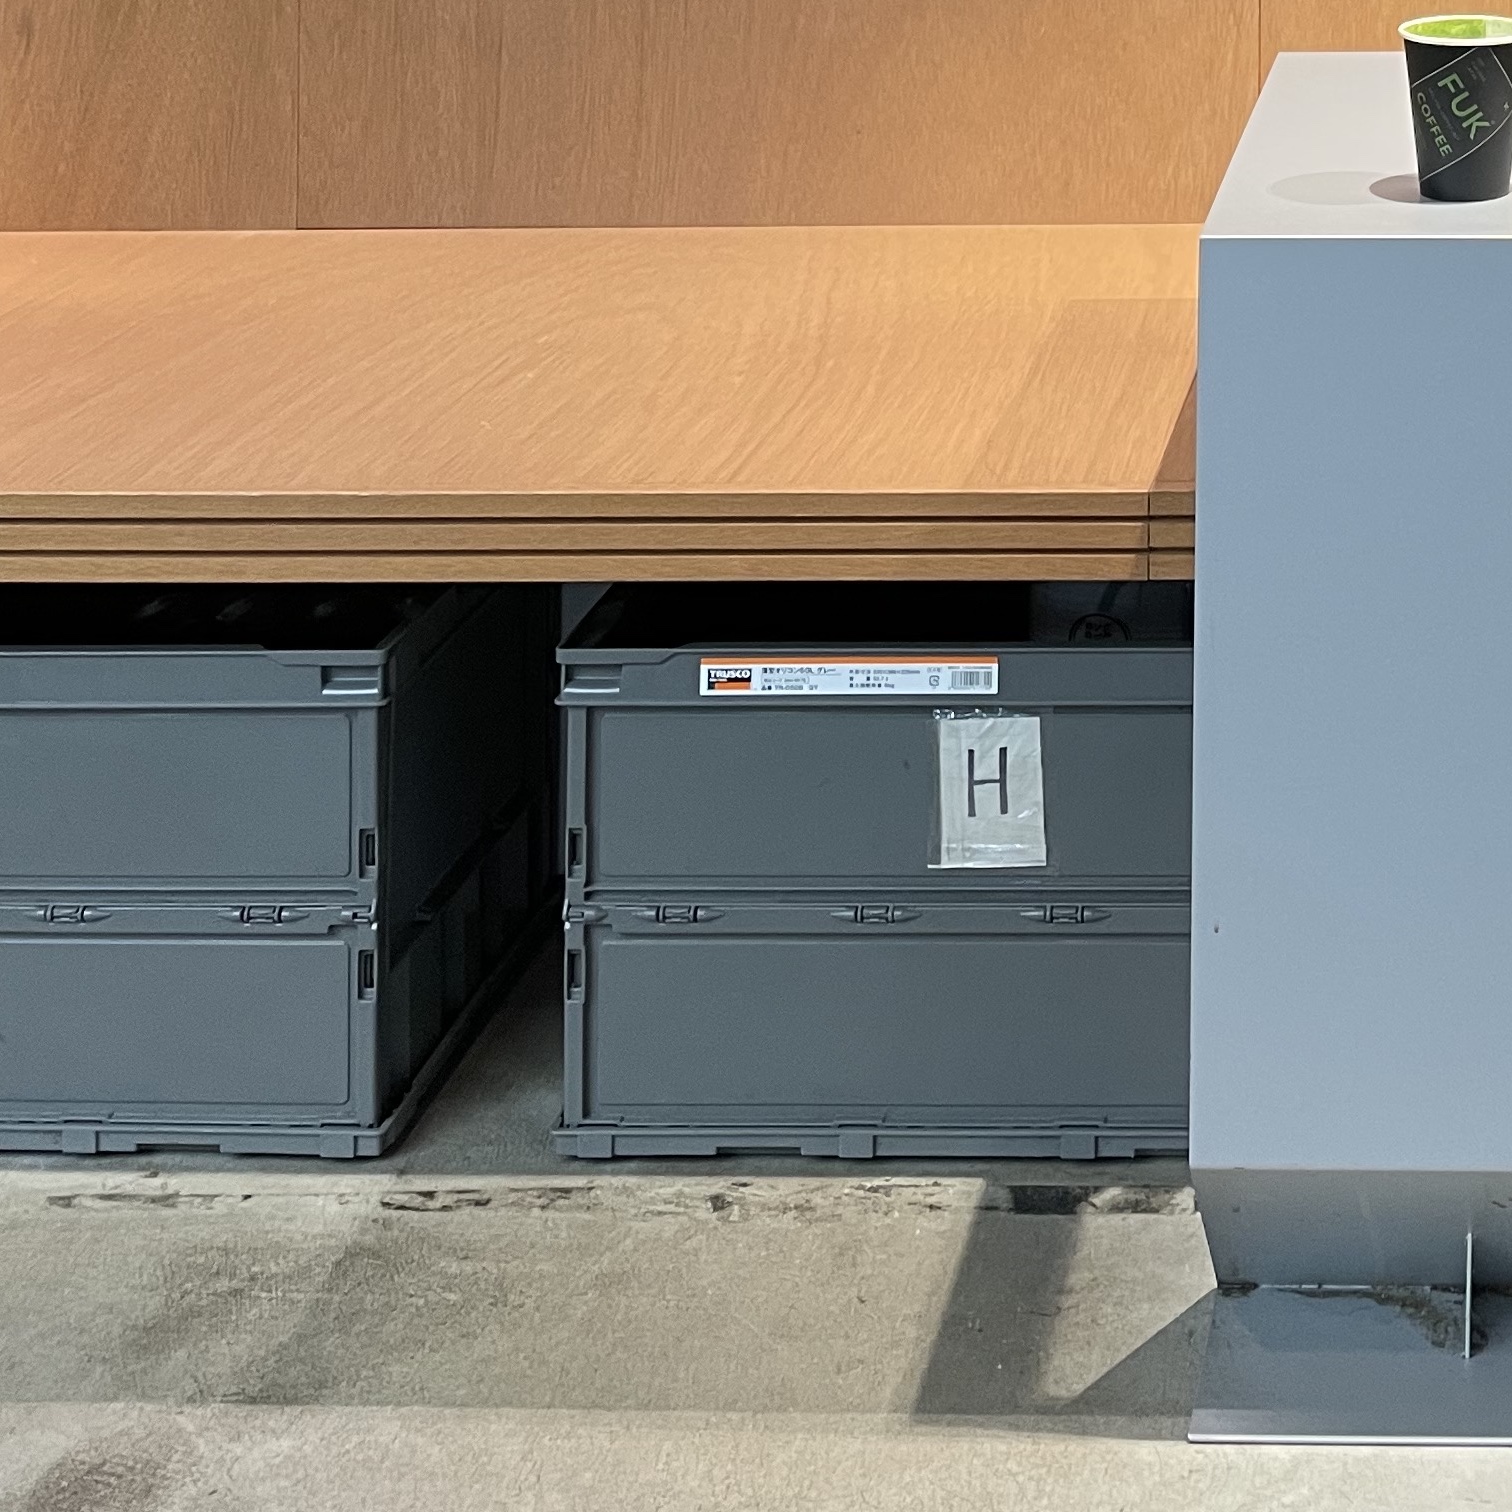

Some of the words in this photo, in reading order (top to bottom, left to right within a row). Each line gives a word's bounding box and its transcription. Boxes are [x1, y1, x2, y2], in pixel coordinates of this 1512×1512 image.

[1417, 92, 1453, 157] COFFEE
[1437, 72, 1492, 141] FUK
[709, 669, 751, 679] TRUSCO
[968, 746, 1008, 818] H
